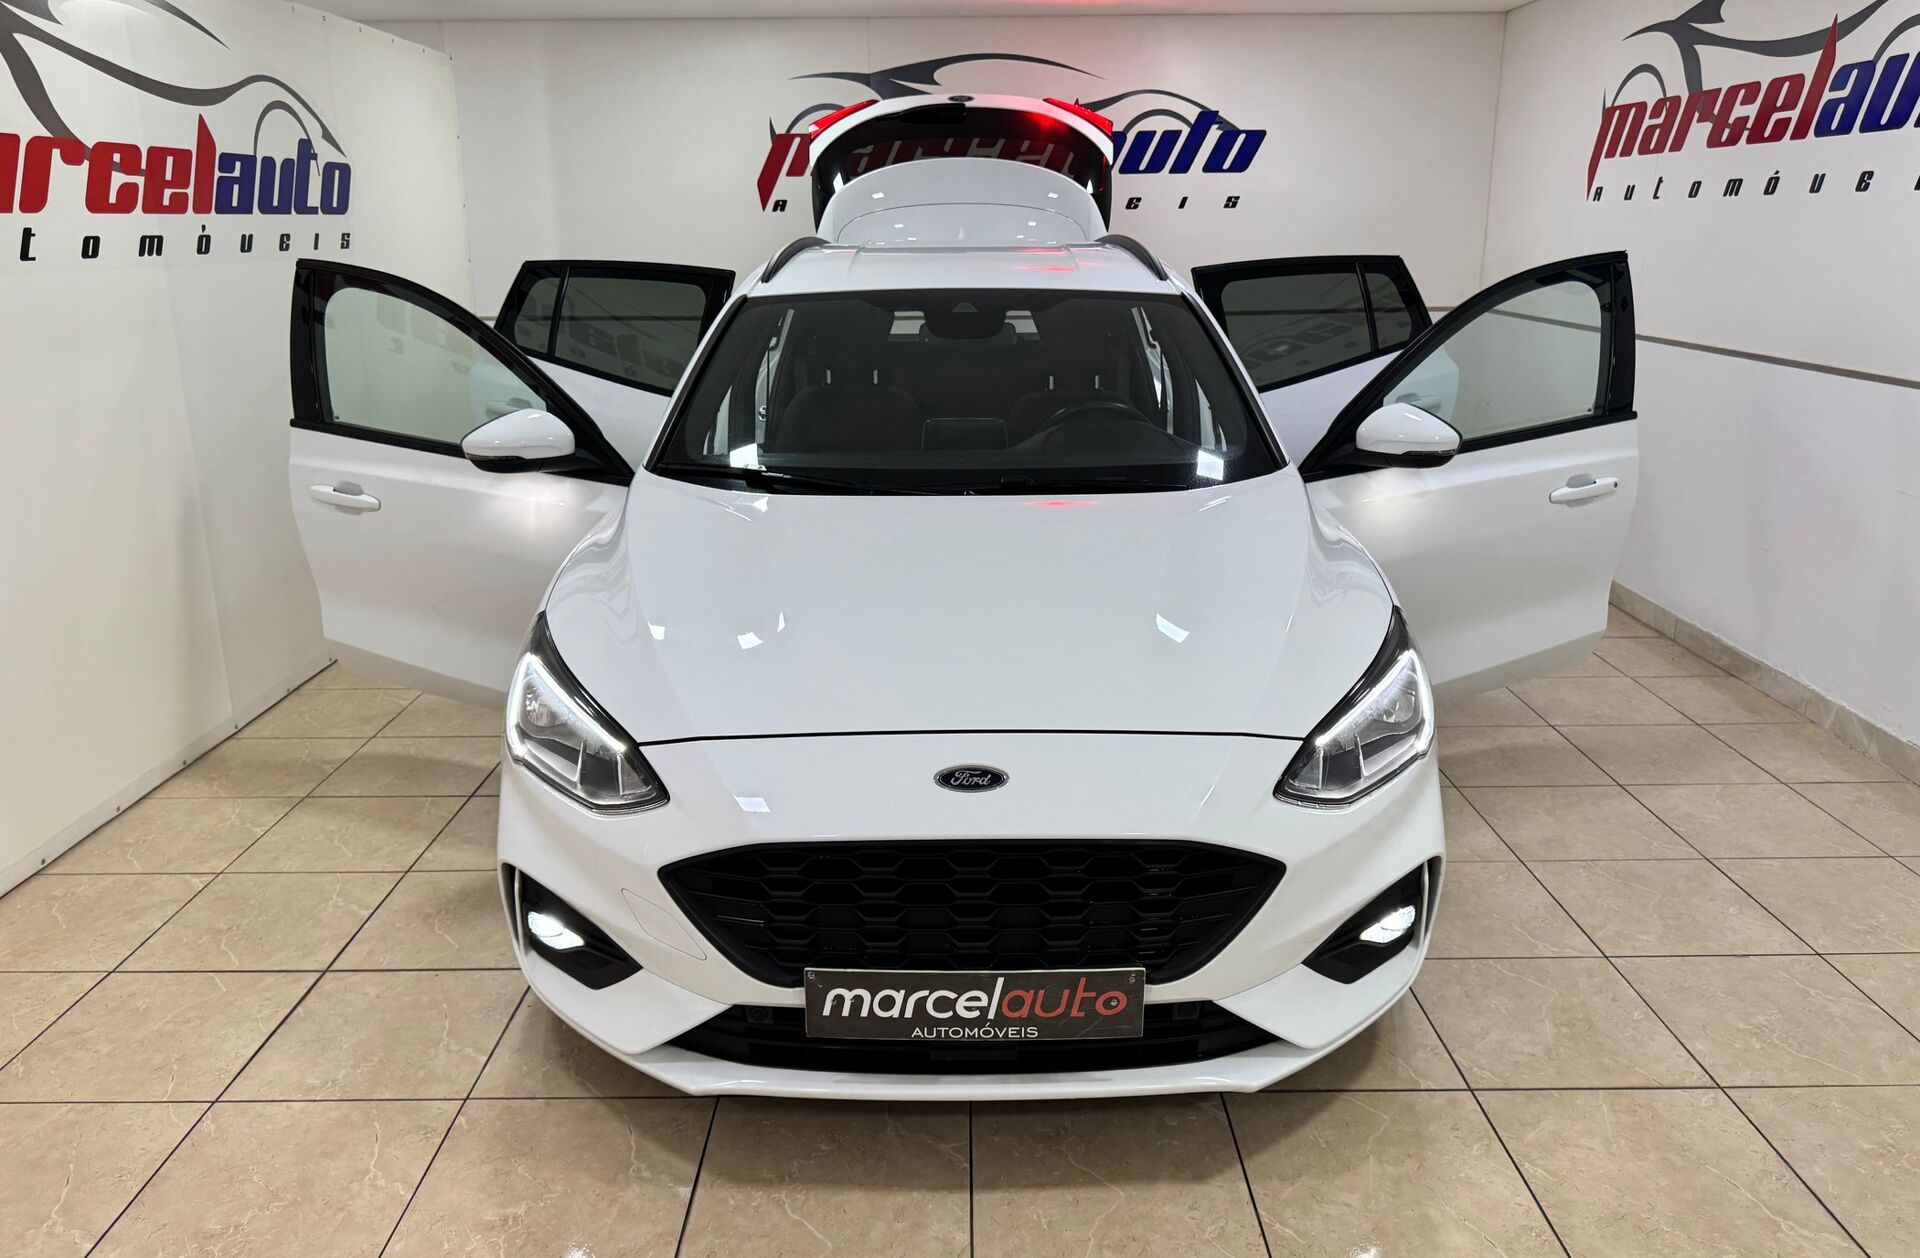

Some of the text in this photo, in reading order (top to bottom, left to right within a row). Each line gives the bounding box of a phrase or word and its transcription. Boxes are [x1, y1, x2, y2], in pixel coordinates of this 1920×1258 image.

[1586, 13, 1920, 201] marcelau
[950, 770, 992, 786] Ford
[822, 977, 1128, 1020] marcelauto
[911, 1022, 1039, 1039] AUTOMÓVEIS
